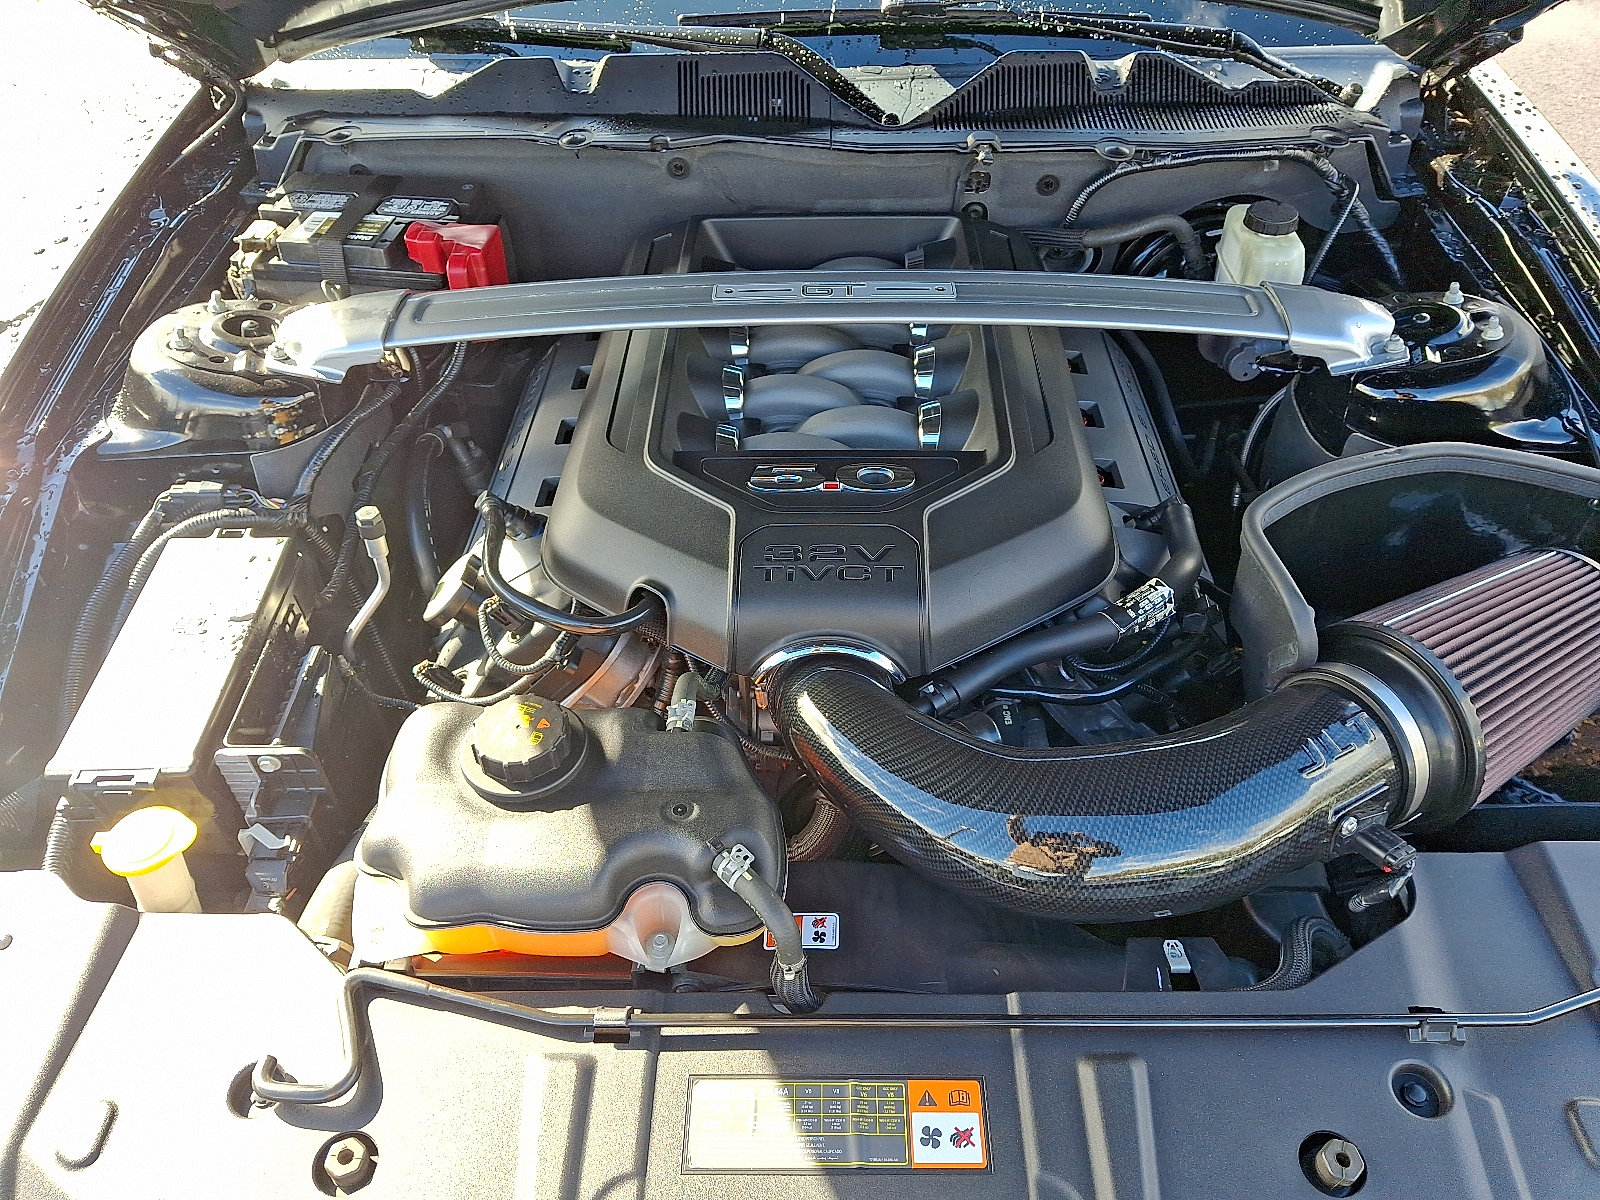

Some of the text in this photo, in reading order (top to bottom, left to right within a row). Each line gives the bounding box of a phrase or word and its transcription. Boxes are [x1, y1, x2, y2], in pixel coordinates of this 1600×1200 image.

[801, 282, 867, 297] GT
[747, 463, 915, 492] 5.0
[764, 543, 896, 562] 32V
[1298, 710, 1377, 779] JLT
